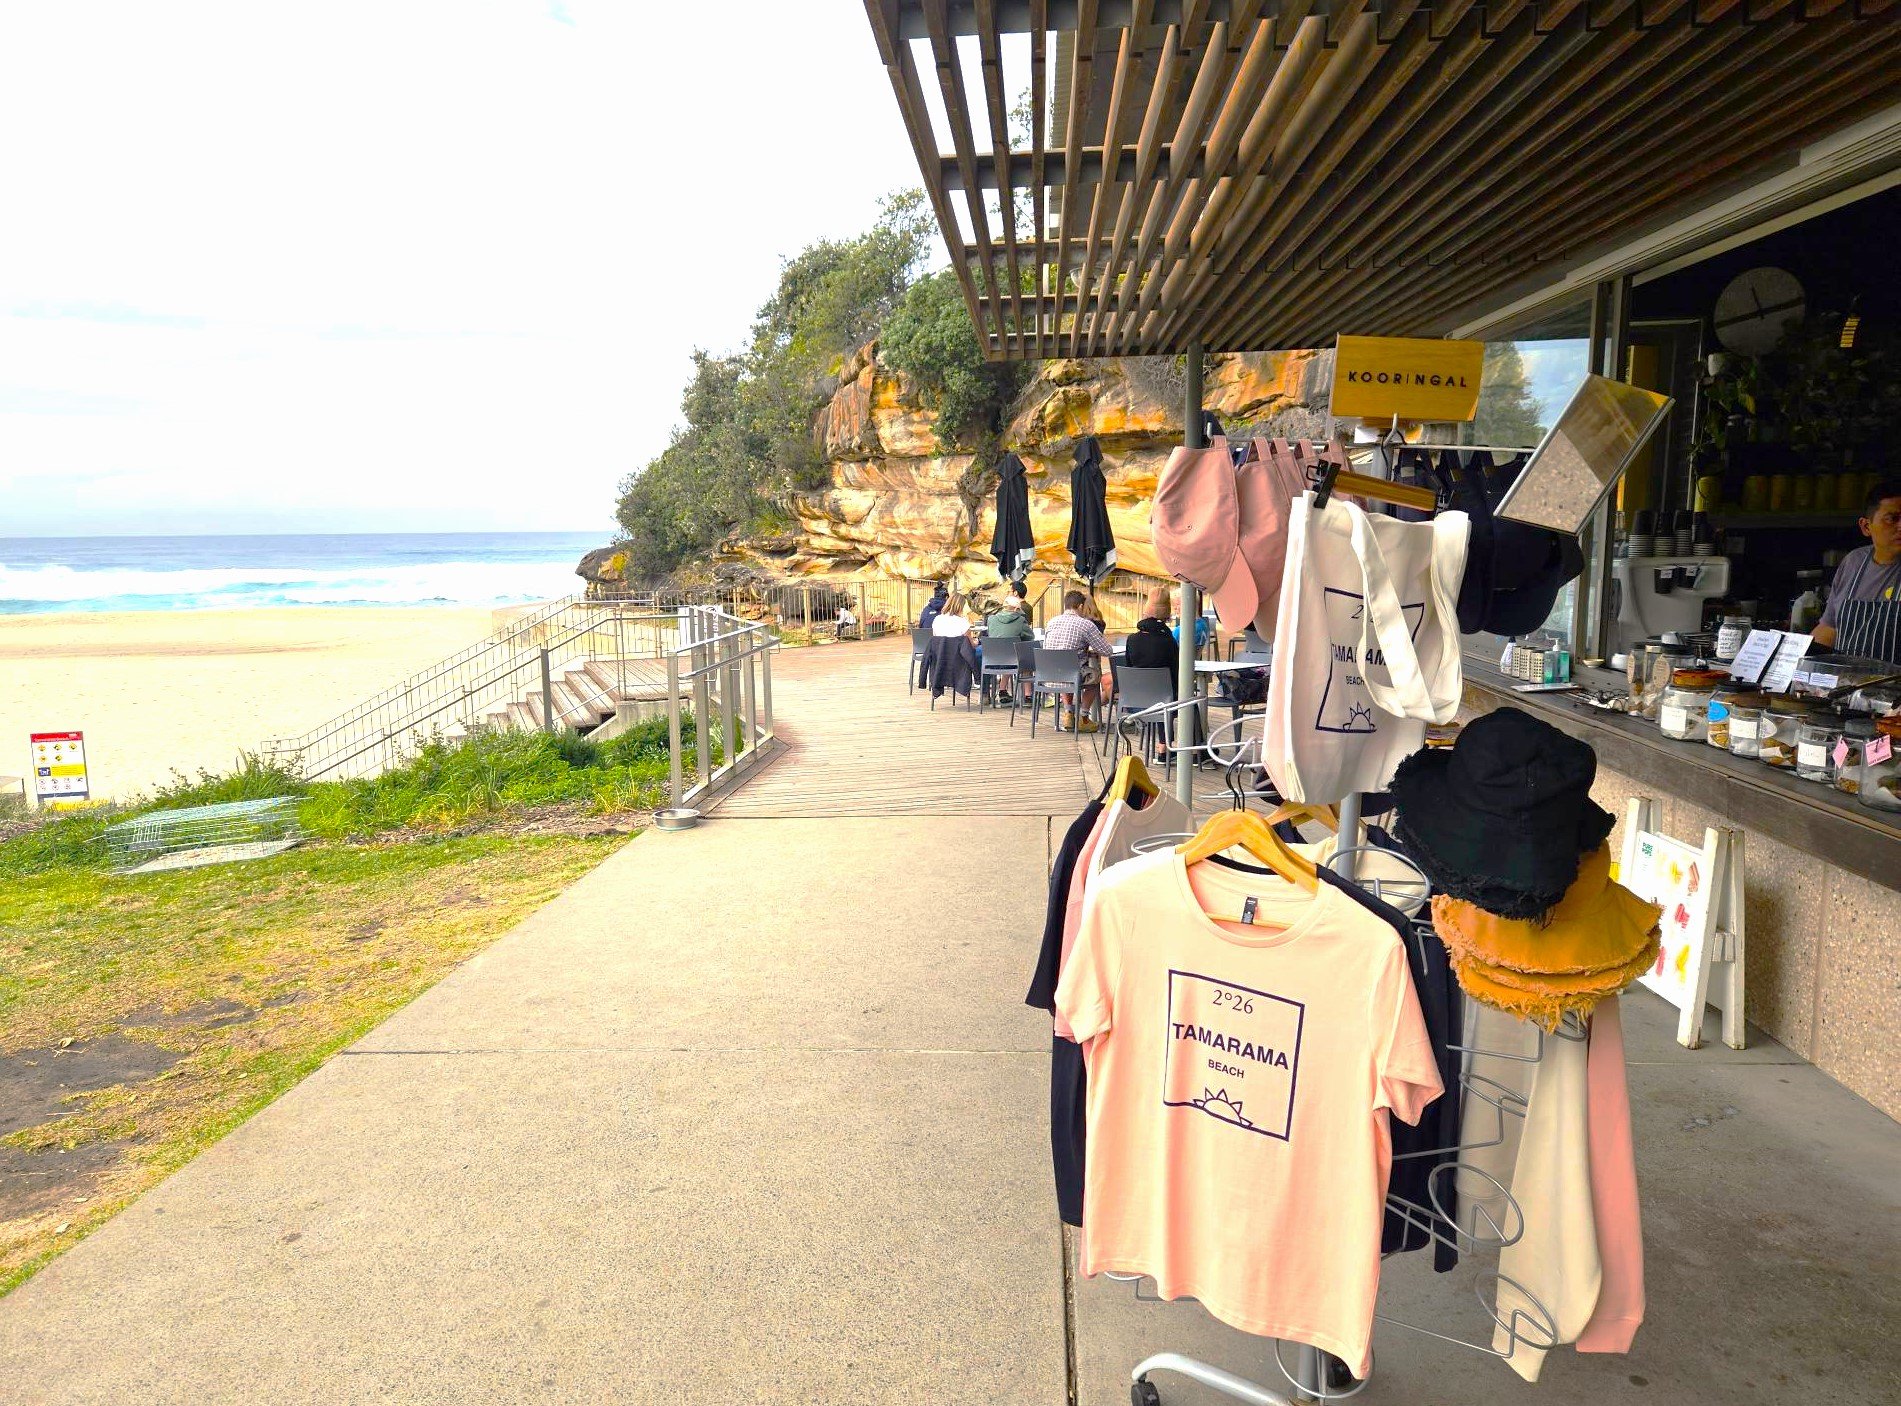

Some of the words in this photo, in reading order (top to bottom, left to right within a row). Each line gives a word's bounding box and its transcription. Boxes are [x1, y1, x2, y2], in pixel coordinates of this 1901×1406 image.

[1348, 371, 1467, 388] KOORINGAL
[1212, 989, 1253, 1014] 2°26
[1172, 1023, 1289, 1069] TAMARAMA
[1208, 1059, 1245, 1078] BEACH
